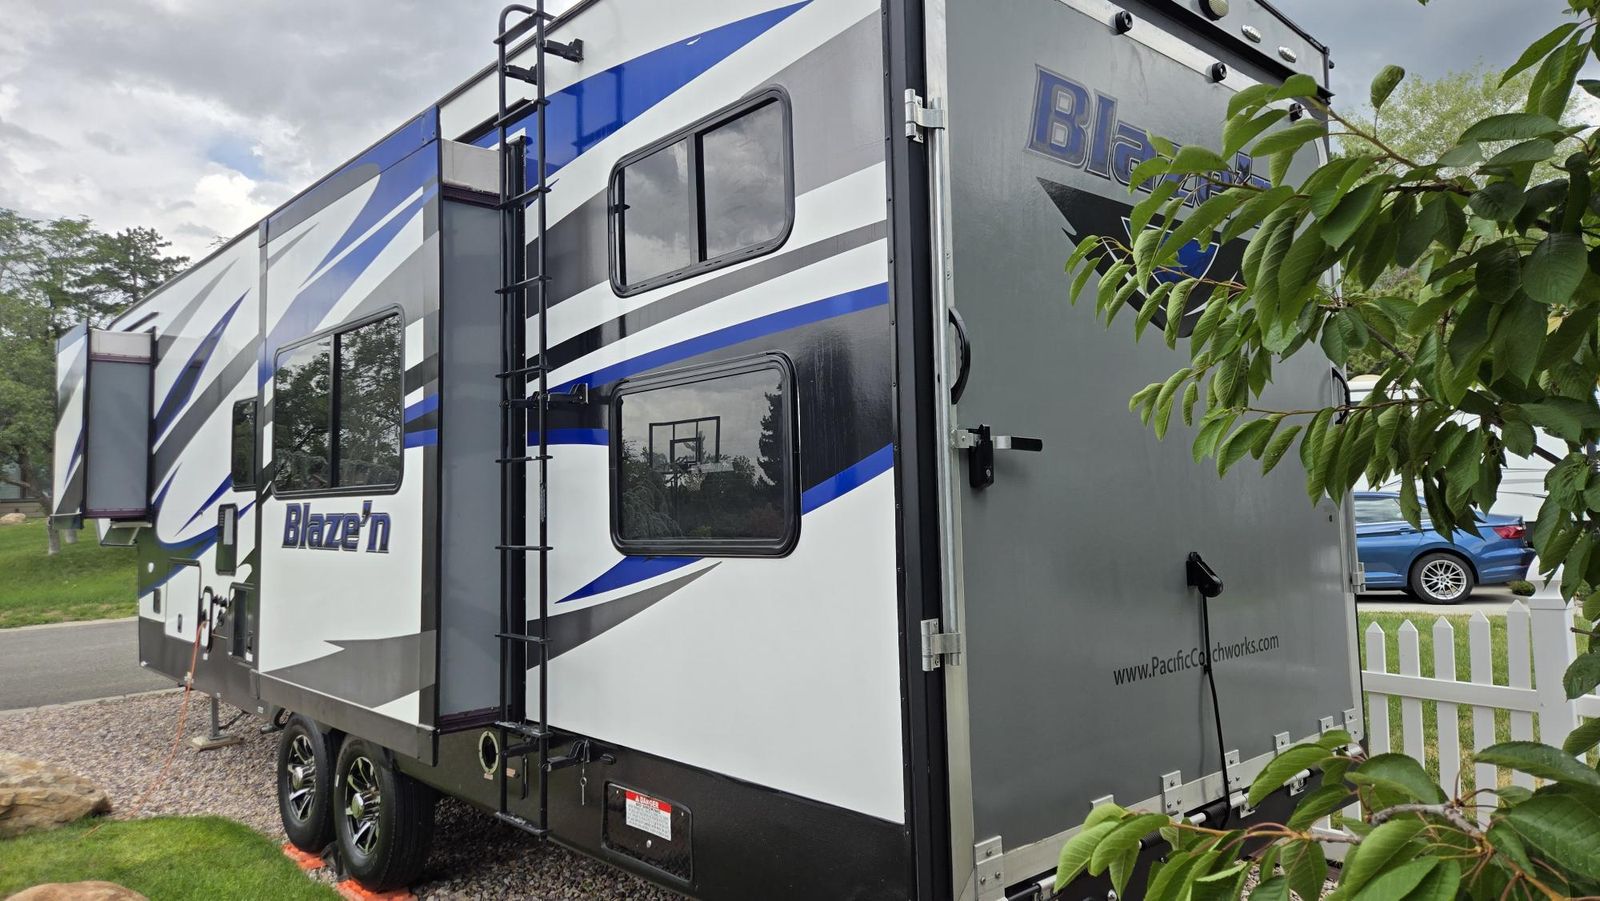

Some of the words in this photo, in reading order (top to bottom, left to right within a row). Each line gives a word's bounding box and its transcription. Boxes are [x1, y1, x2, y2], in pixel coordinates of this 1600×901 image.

[1023, 63, 1272, 230] Bla'
[281, 500, 391, 554] Blaze'n
[1113, 635, 1280, 686] www.PacificCochworks.com
[640, 796, 659, 809] DANGER
